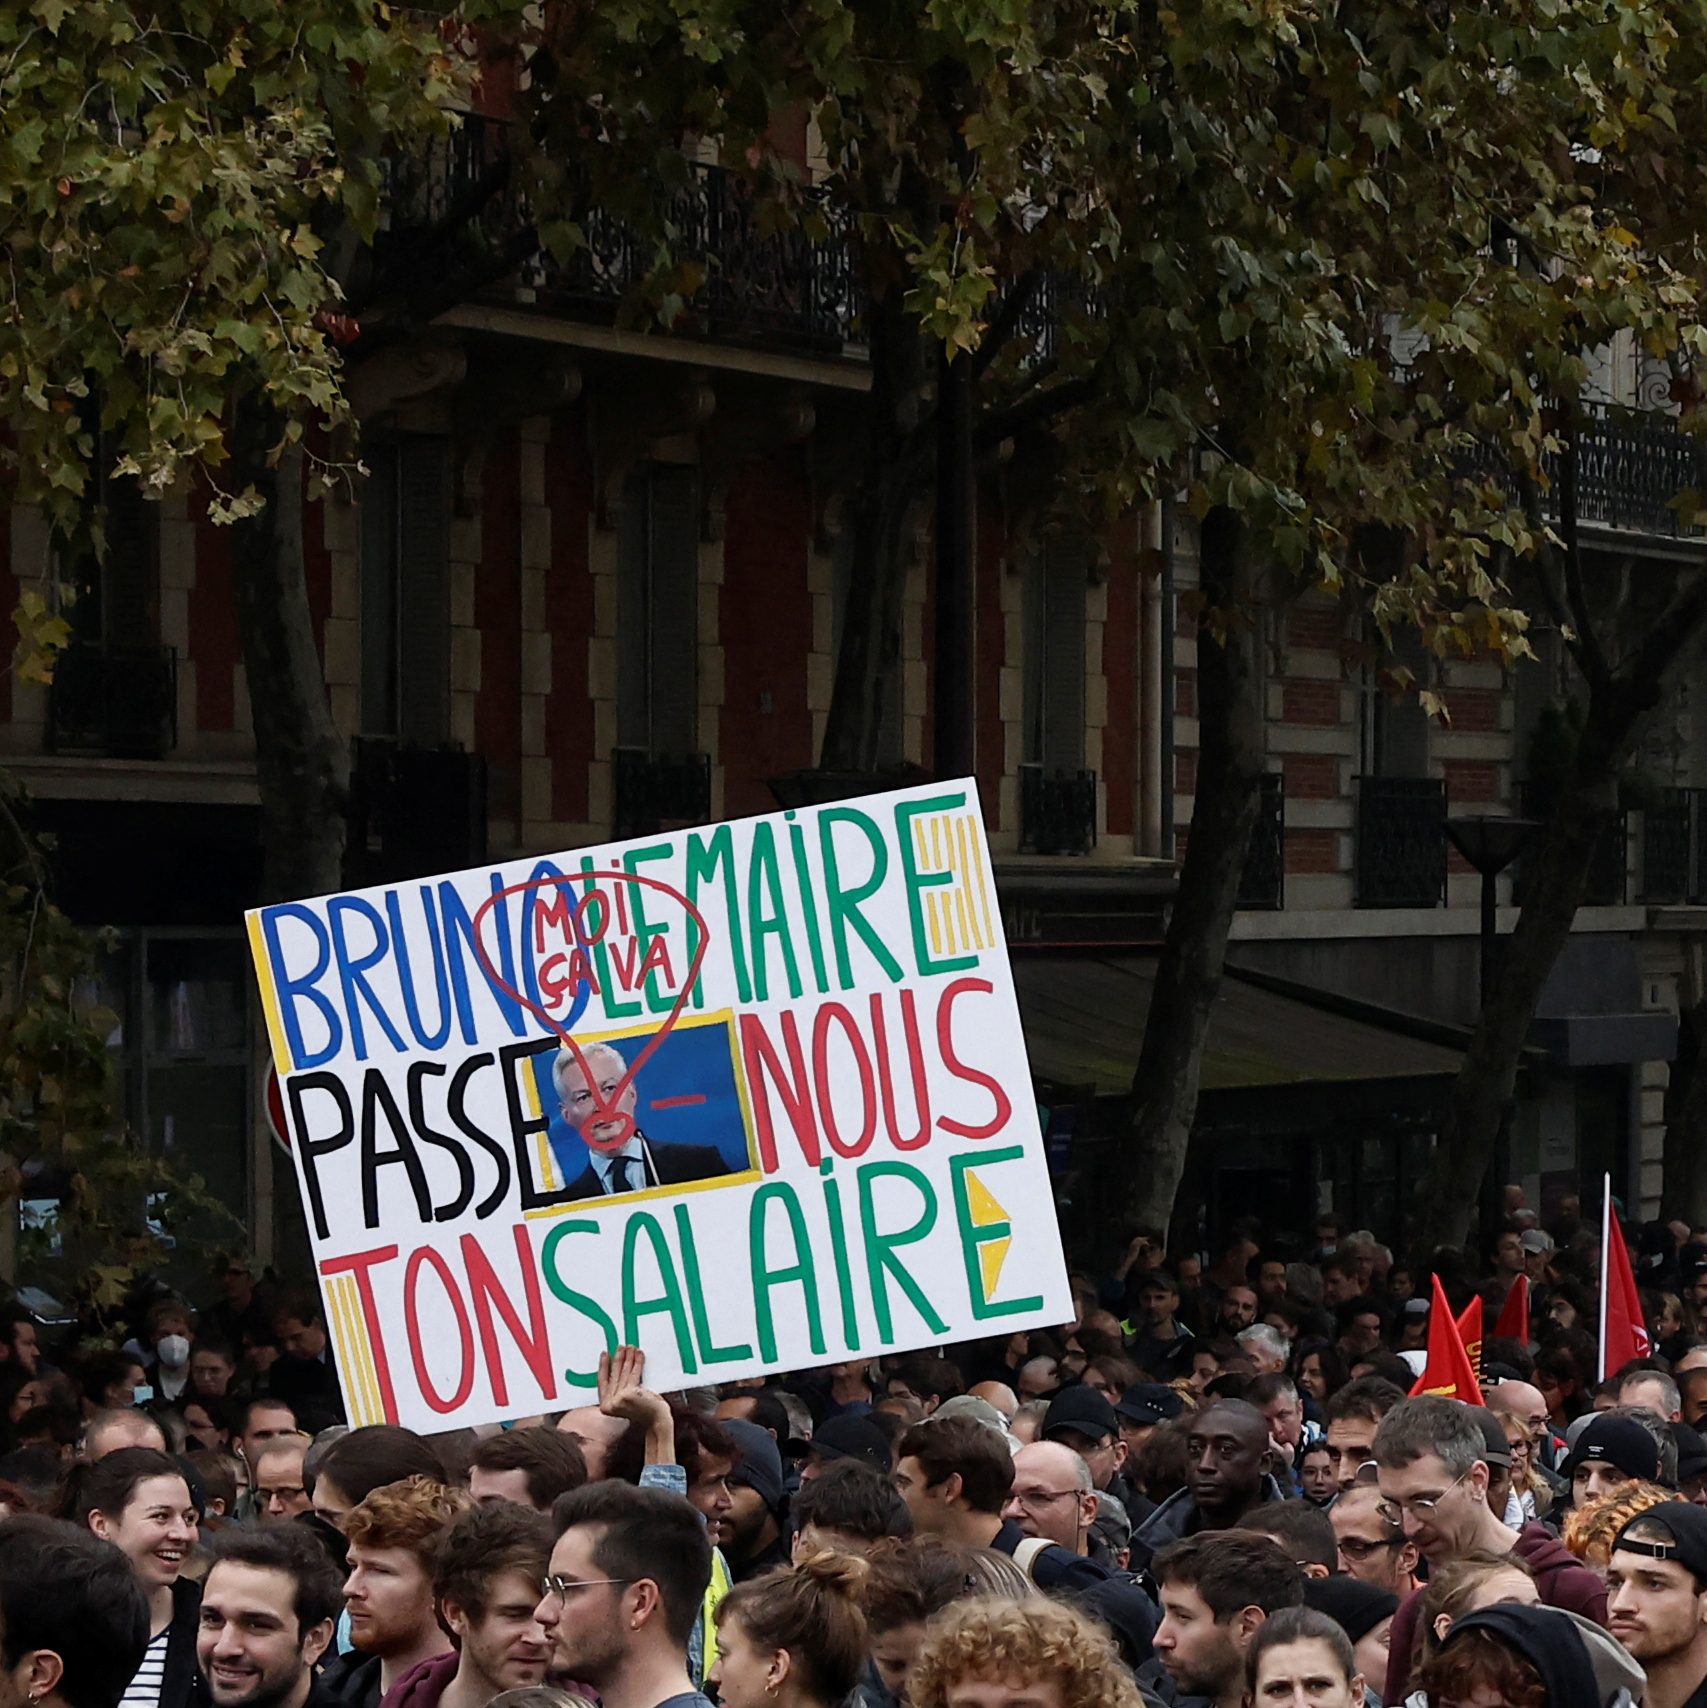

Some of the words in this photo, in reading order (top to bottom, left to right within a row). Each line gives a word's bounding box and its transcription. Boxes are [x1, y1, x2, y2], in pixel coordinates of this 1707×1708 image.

[260, 858, 591, 1070] BRUNO
[607, 934, 677, 992] VA
[285, 1036, 563, 1240] PASSE
[739, 978, 1012, 1174] NOUS
[320, 1223, 557, 1426] TON
